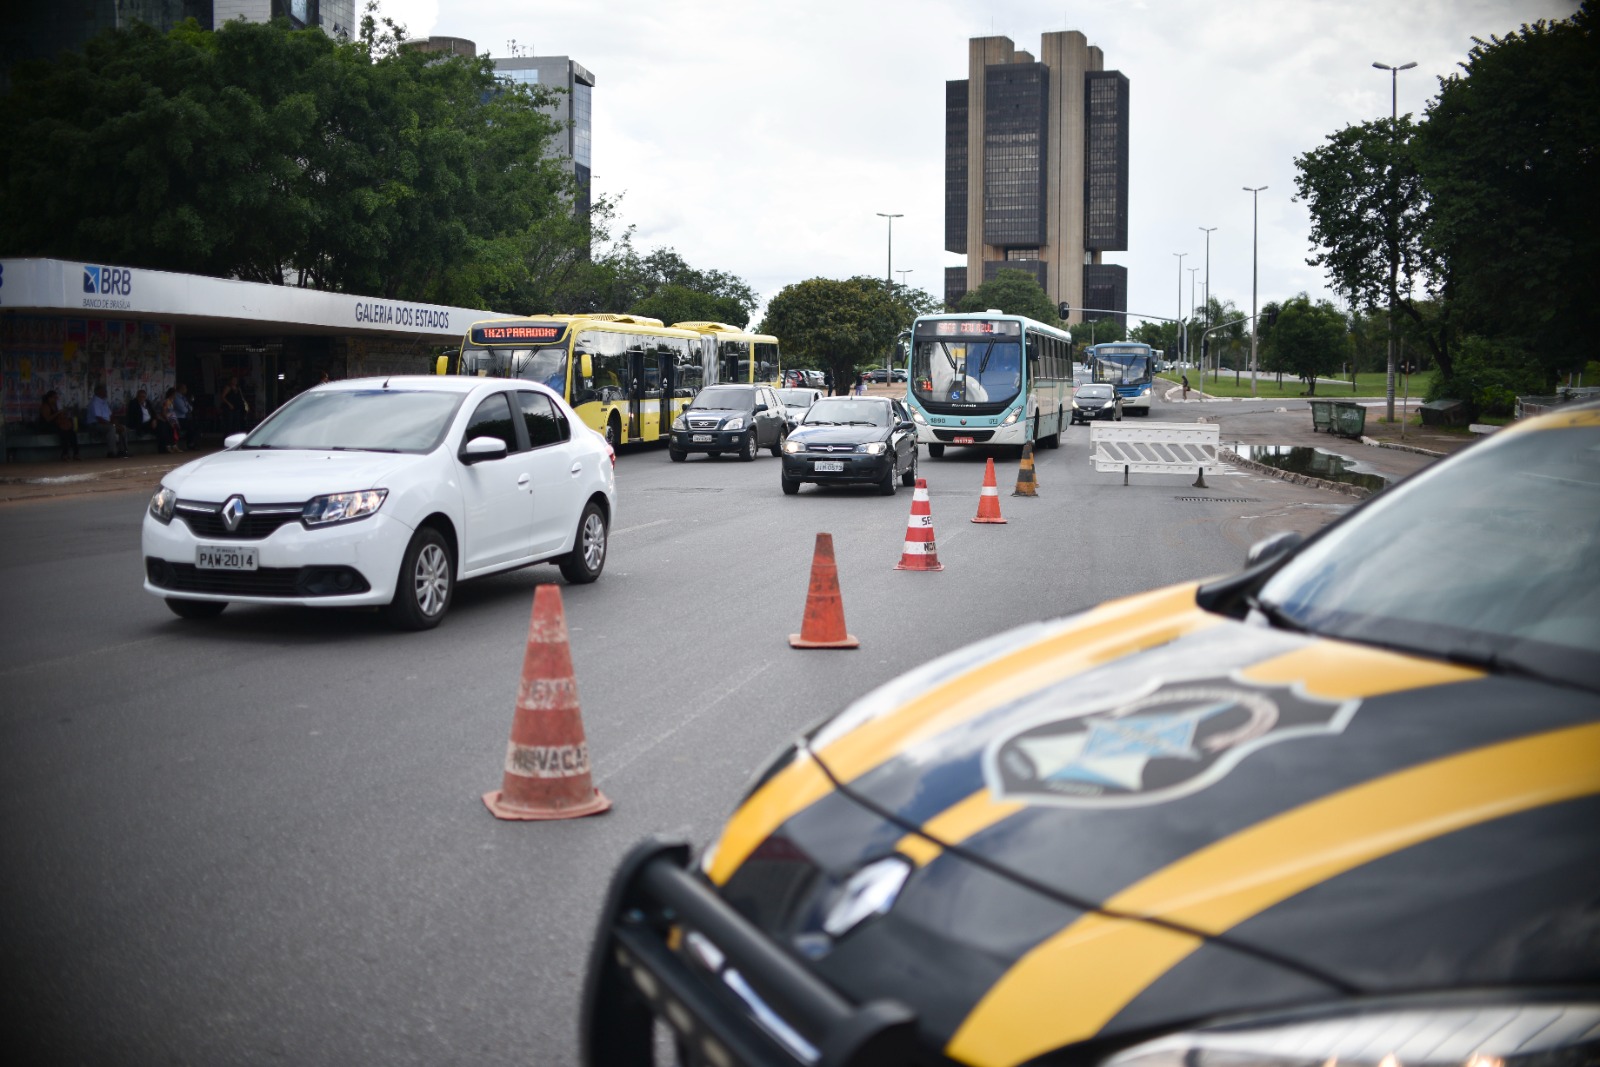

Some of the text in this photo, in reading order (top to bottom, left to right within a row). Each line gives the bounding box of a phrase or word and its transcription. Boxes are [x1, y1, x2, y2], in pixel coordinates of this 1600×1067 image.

[101, 268, 131, 296] BRB
[355, 302, 449, 329] GALERIA DOS ESTADOS
